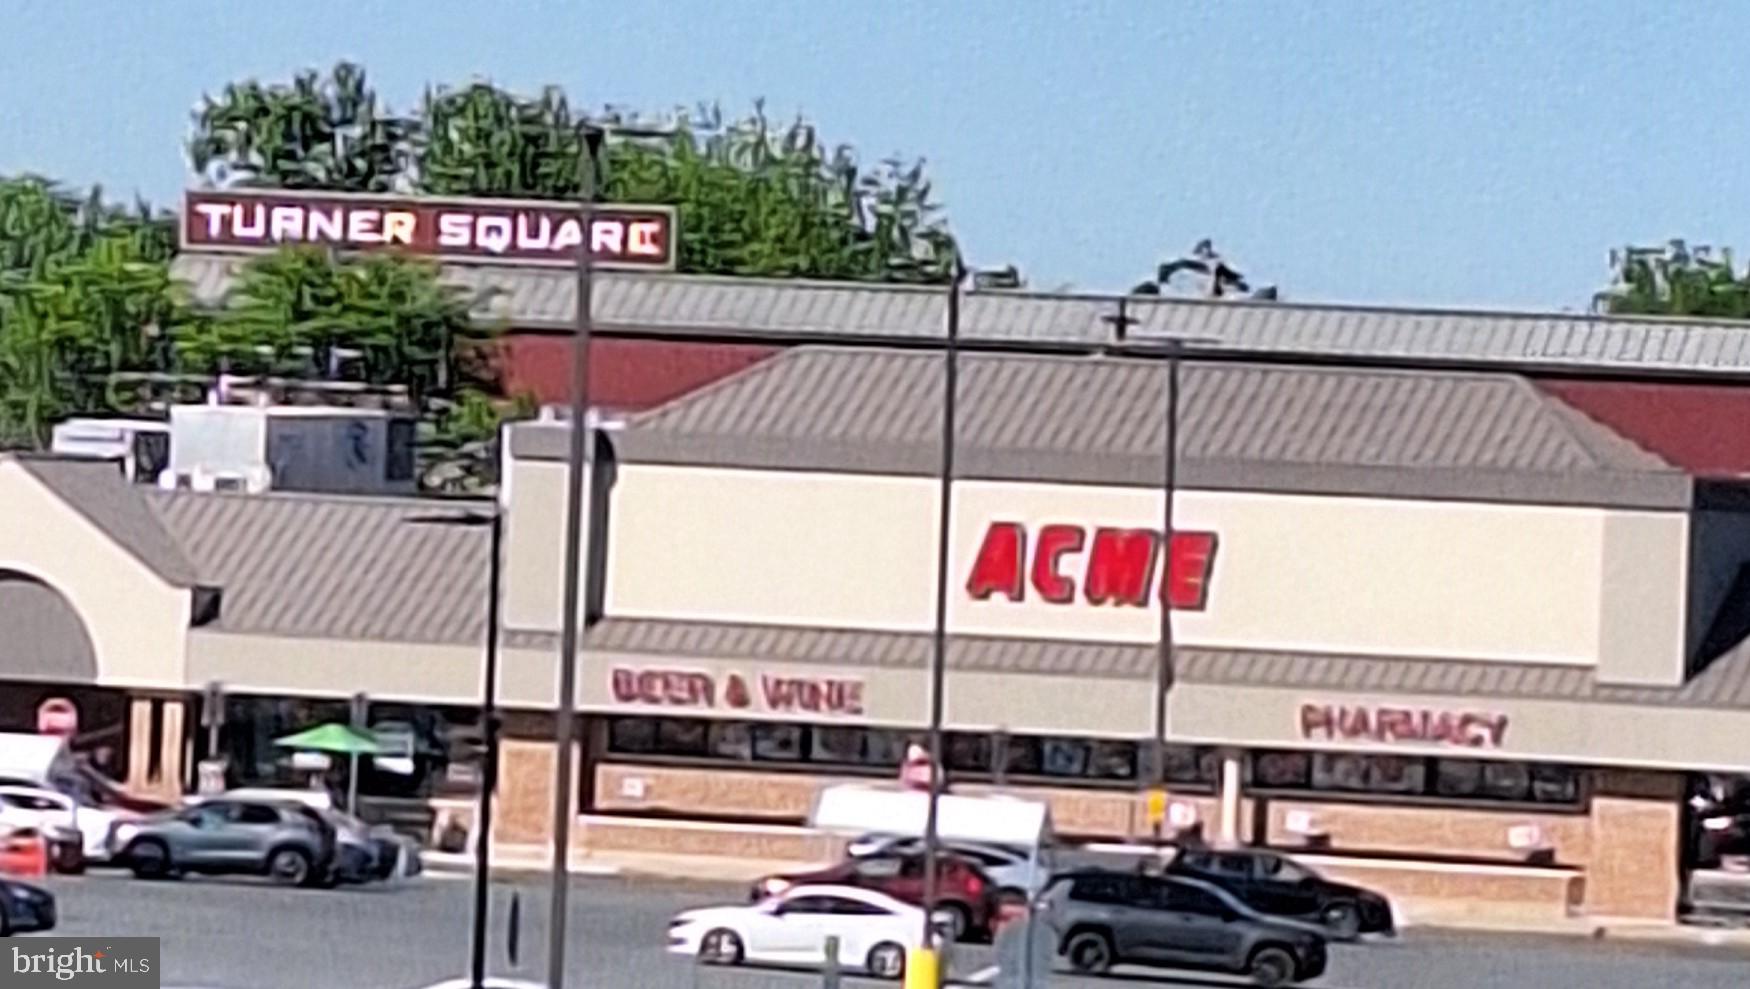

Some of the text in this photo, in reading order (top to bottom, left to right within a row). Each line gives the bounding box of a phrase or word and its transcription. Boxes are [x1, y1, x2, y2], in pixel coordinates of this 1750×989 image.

[195, 203, 662, 255] TURNER SQUARE
[965, 521, 1219, 612] ACME
[613, 669, 865, 715] BEER & WINE
[1301, 704, 1508, 747] PHARMACY
